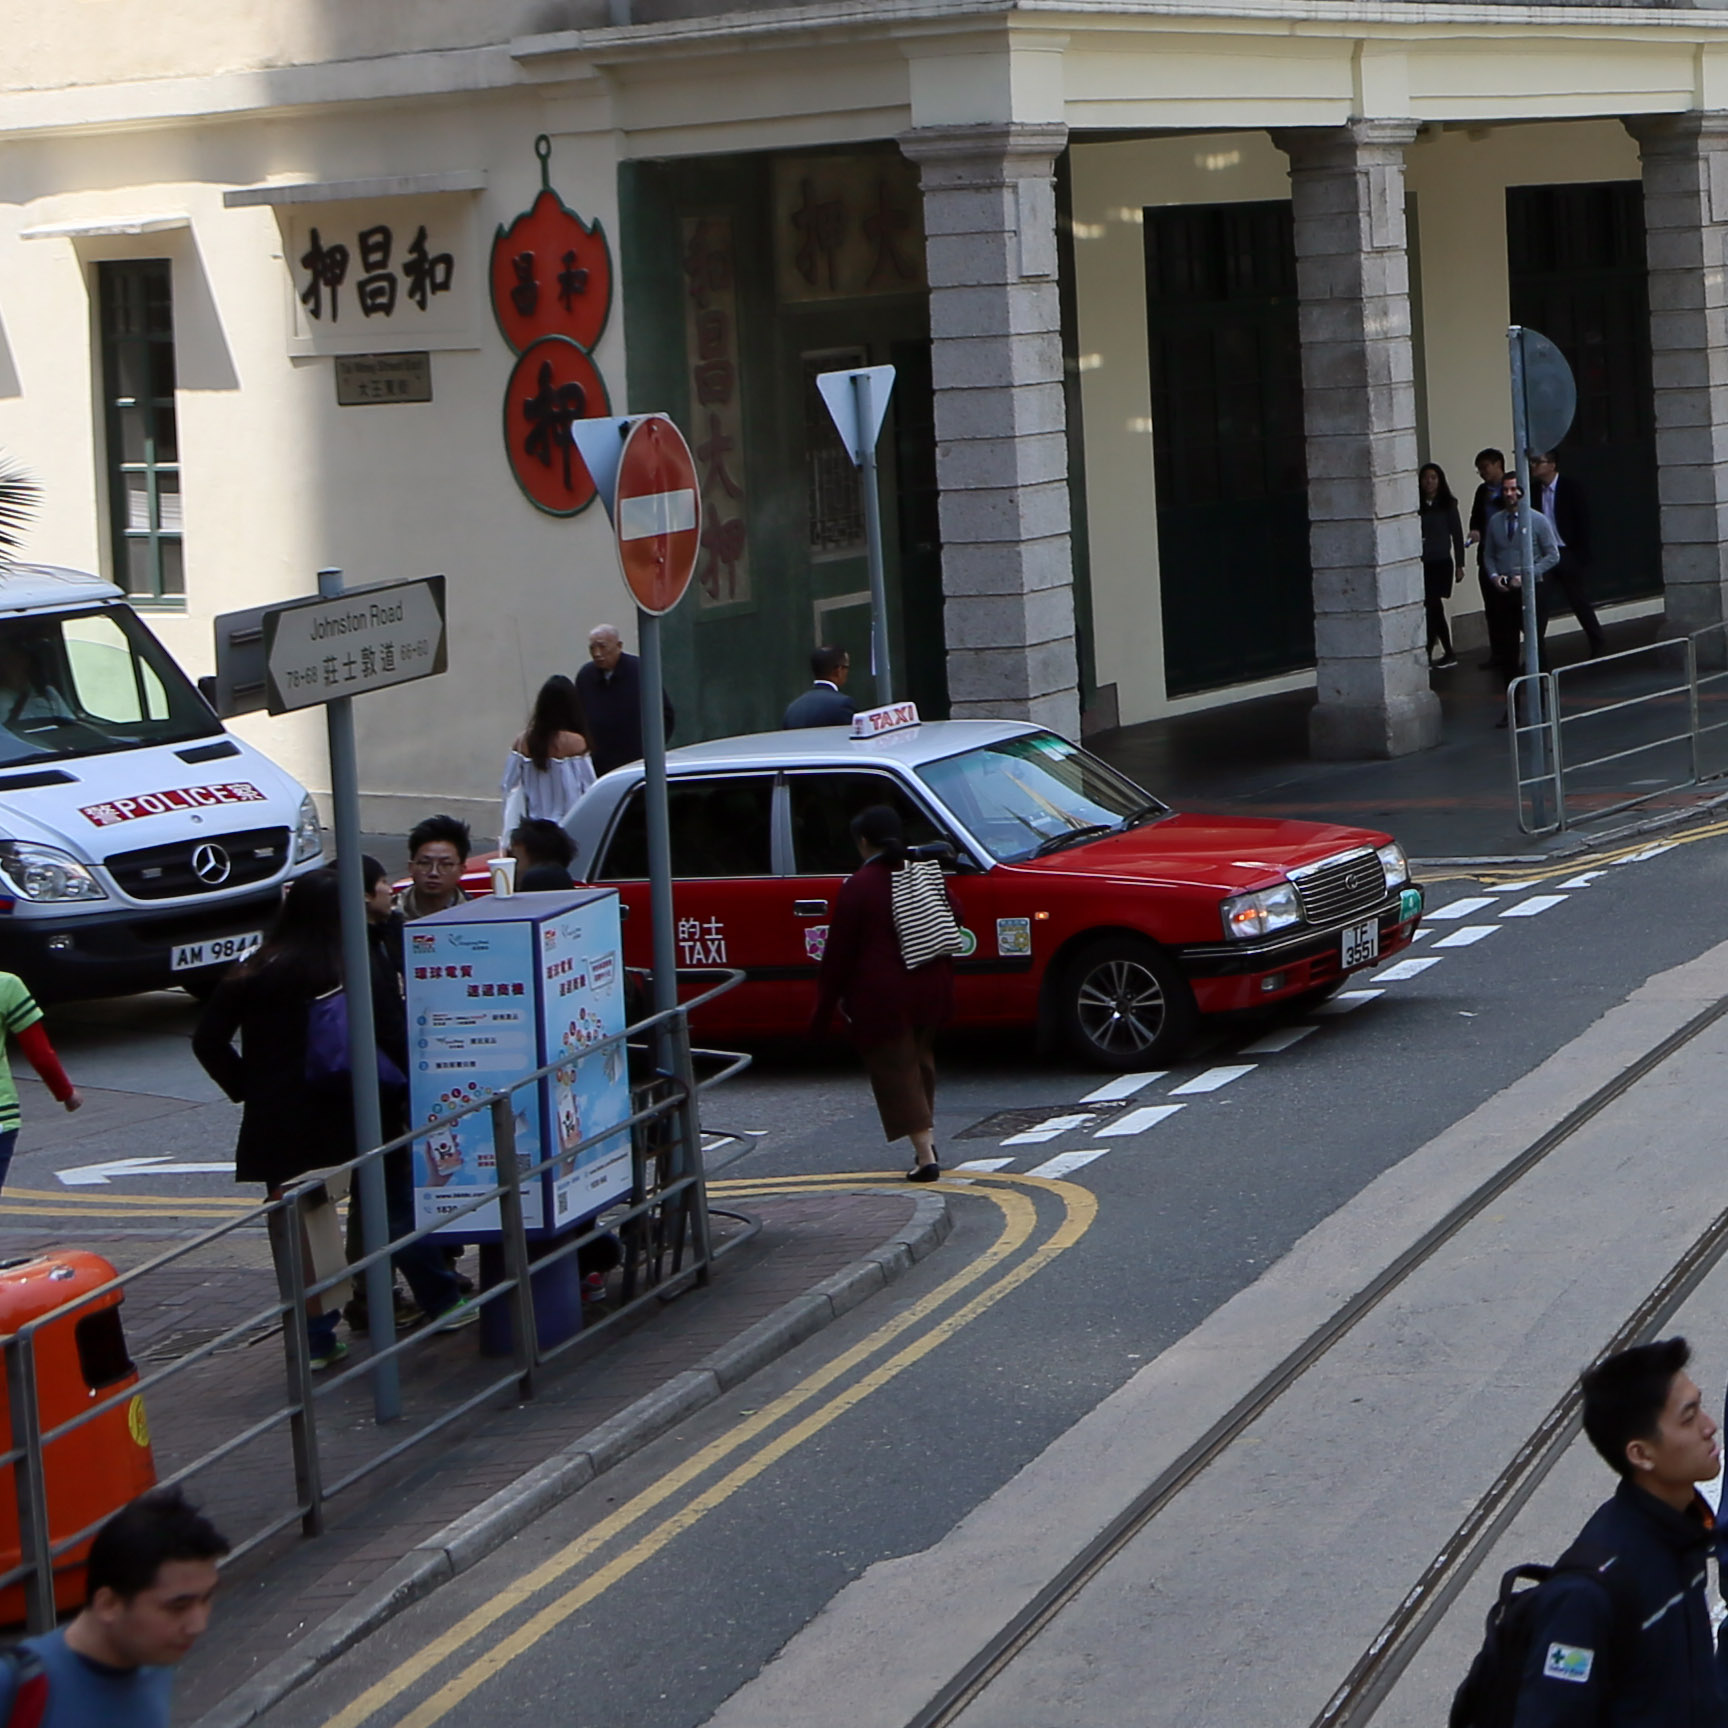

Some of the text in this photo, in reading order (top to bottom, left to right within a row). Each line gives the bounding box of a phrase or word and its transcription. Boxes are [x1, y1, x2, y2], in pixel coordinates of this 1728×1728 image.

[523, 360, 586, 492] 押
[310, 601, 403, 642] Johnston Road
[322, 641, 396, 687] 莊士敦道
[869, 704, 915, 731] TAXI
[114, 785, 238, 820] POLICE
[679, 916, 724, 941] 的士
[1353, 923, 1369, 944] TF
[176, 949, 201, 967] AM
[680, 940, 727, 965] TAXI
[1346, 938, 1374, 965] 3551
